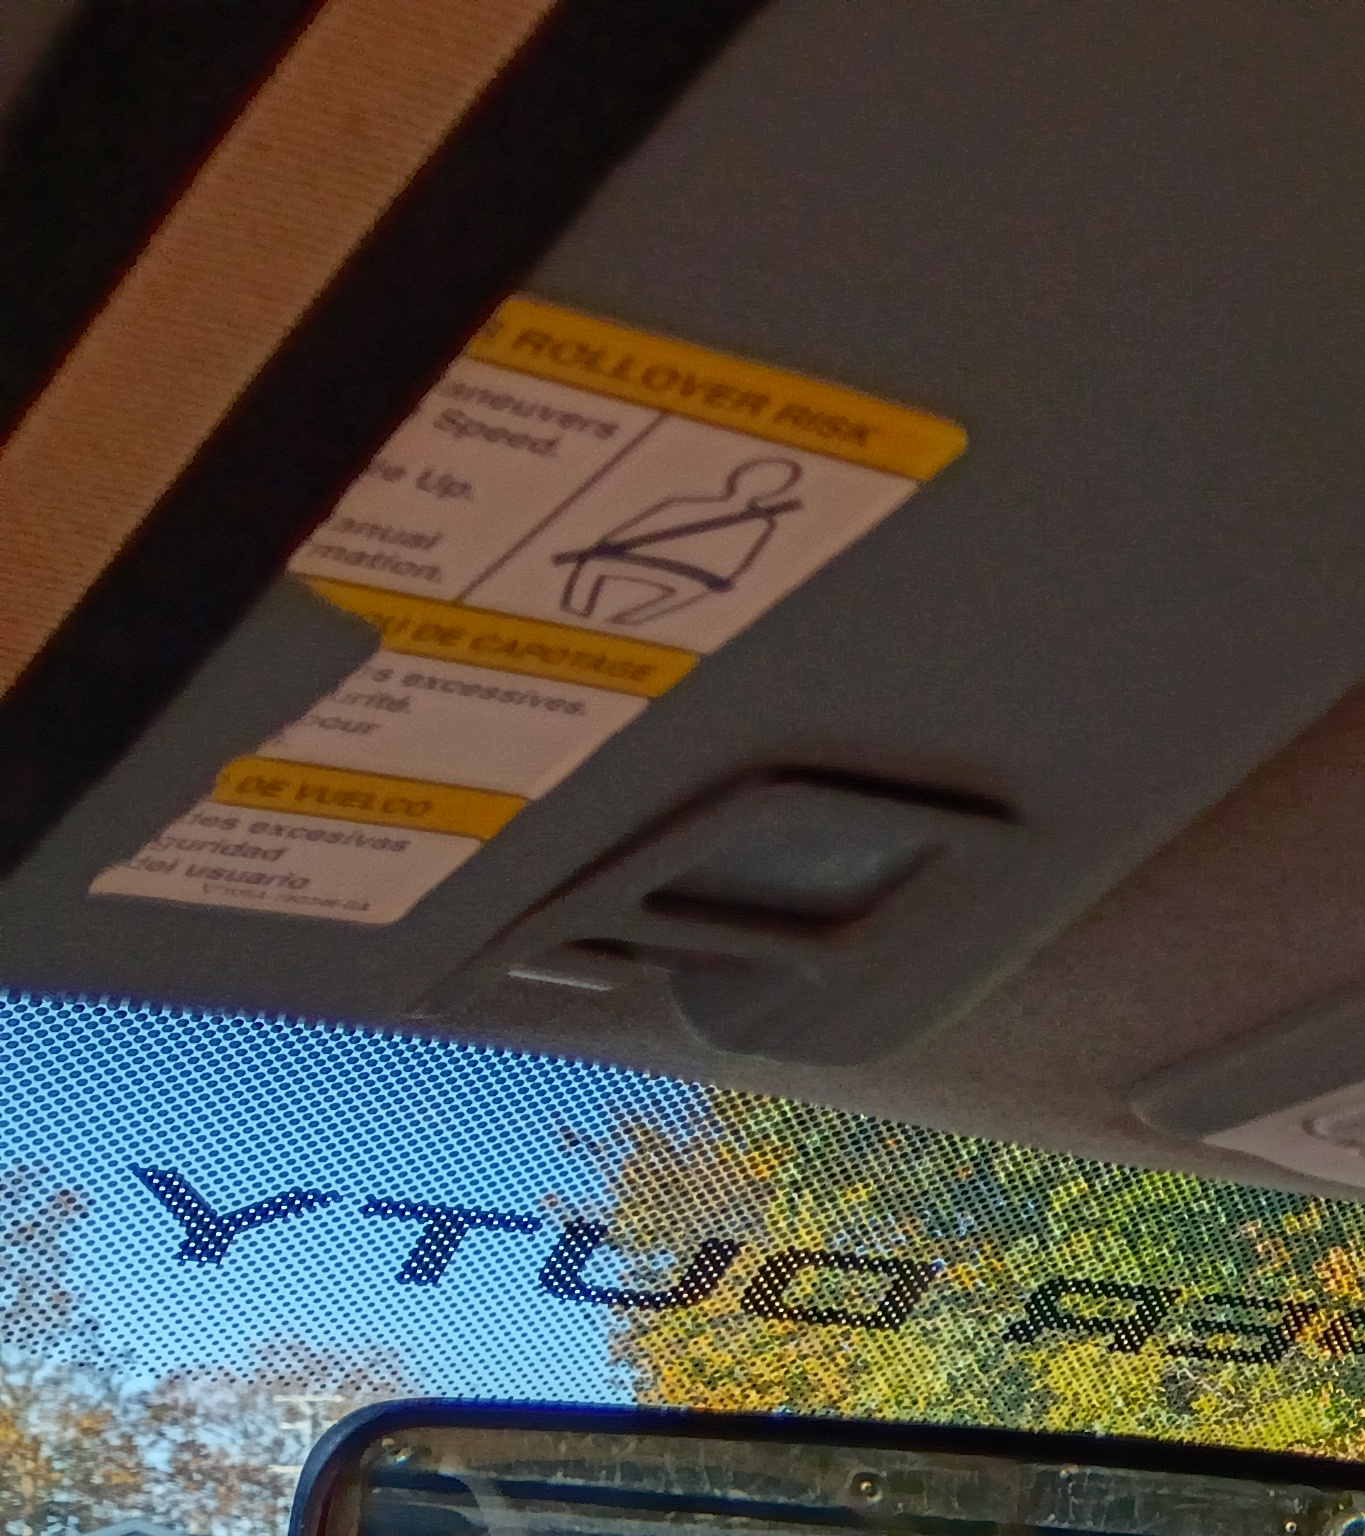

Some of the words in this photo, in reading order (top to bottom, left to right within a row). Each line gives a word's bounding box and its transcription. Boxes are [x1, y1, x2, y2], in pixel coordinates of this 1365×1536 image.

[511, 327, 771, 416] ROLLOVER
[773, 403, 878, 448] RISK
[433, 408, 559, 456] Speed.
[440, 381, 619, 440] aneuvers
[330, 517, 442, 550] anual
[312, 544, 442, 583] mation.
[411, 622, 470, 647] DE
[469, 634, 657, 682] CAPOTAGE
[235, 774, 290, 798] DE
[294, 783, 432, 817] VUELCO
[162, 837, 286, 862] guridad
[184, 863, 311, 890] usuario
